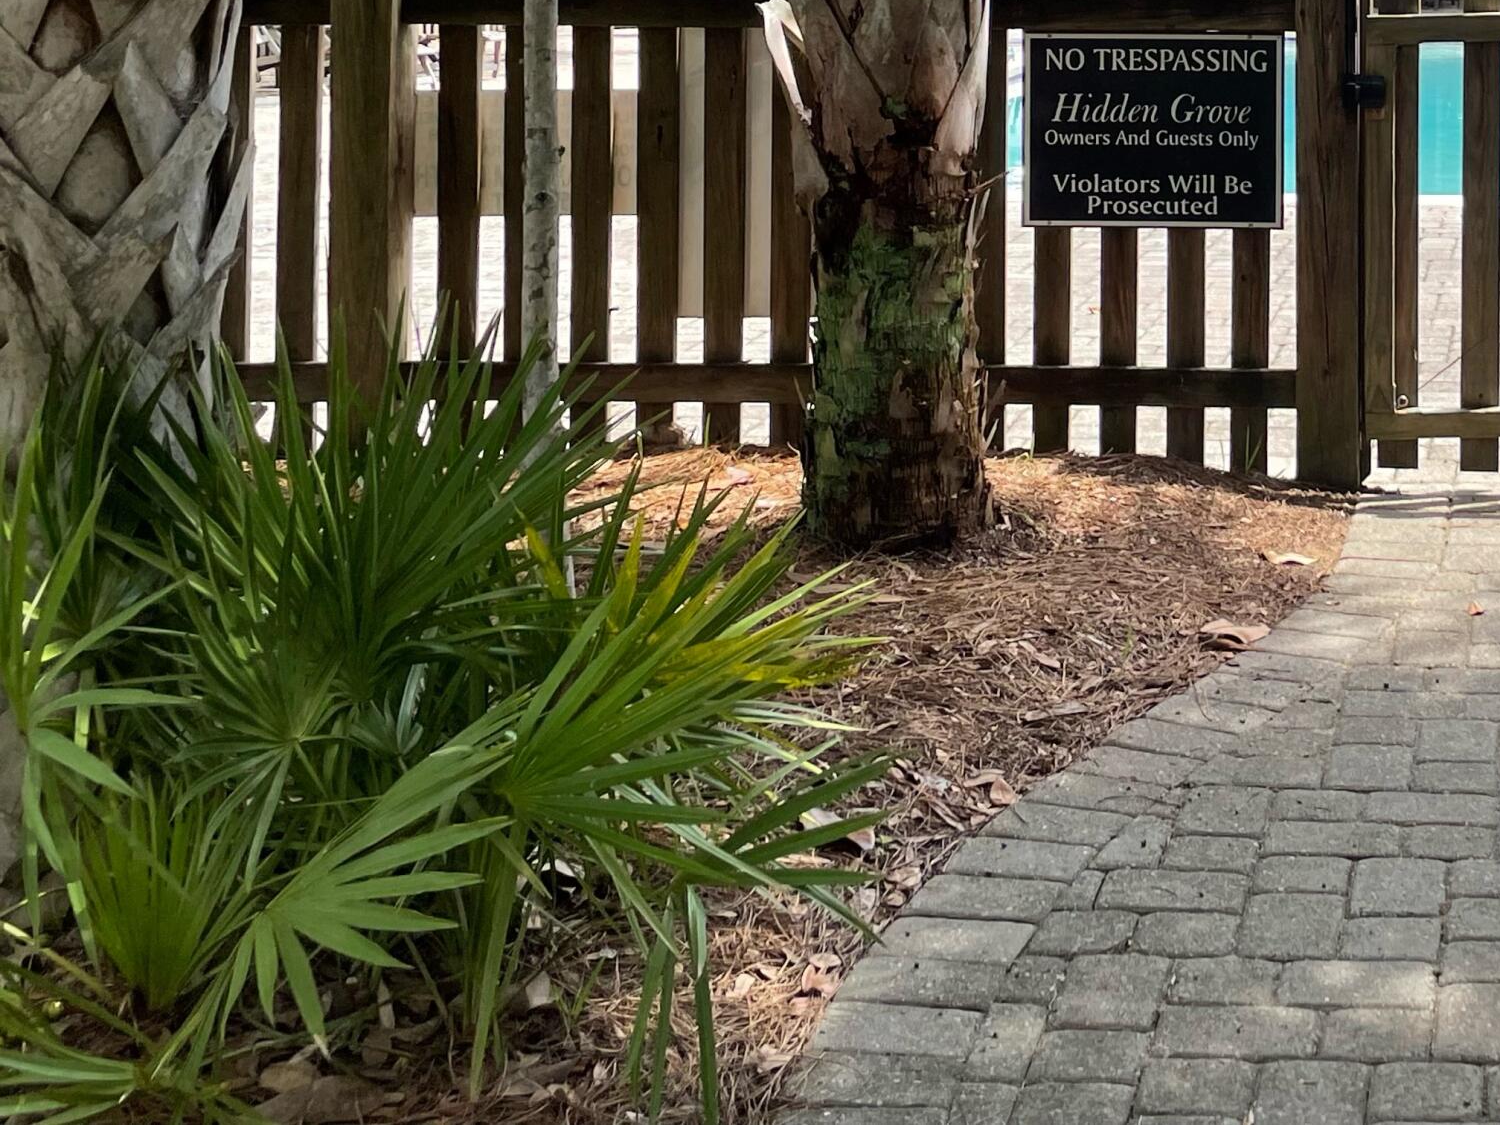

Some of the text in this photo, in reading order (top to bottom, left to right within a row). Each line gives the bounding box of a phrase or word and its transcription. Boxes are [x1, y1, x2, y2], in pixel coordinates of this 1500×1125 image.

[1045, 48, 1268, 73] NO TRESPASSING
[1051, 93, 1252, 124] Hidden Grove
[1044, 129, 1259, 151] Owners And Guests Only
[1053, 173, 1253, 195] Violators Will Be
[1087, 195, 1218, 216] Prosecuted
